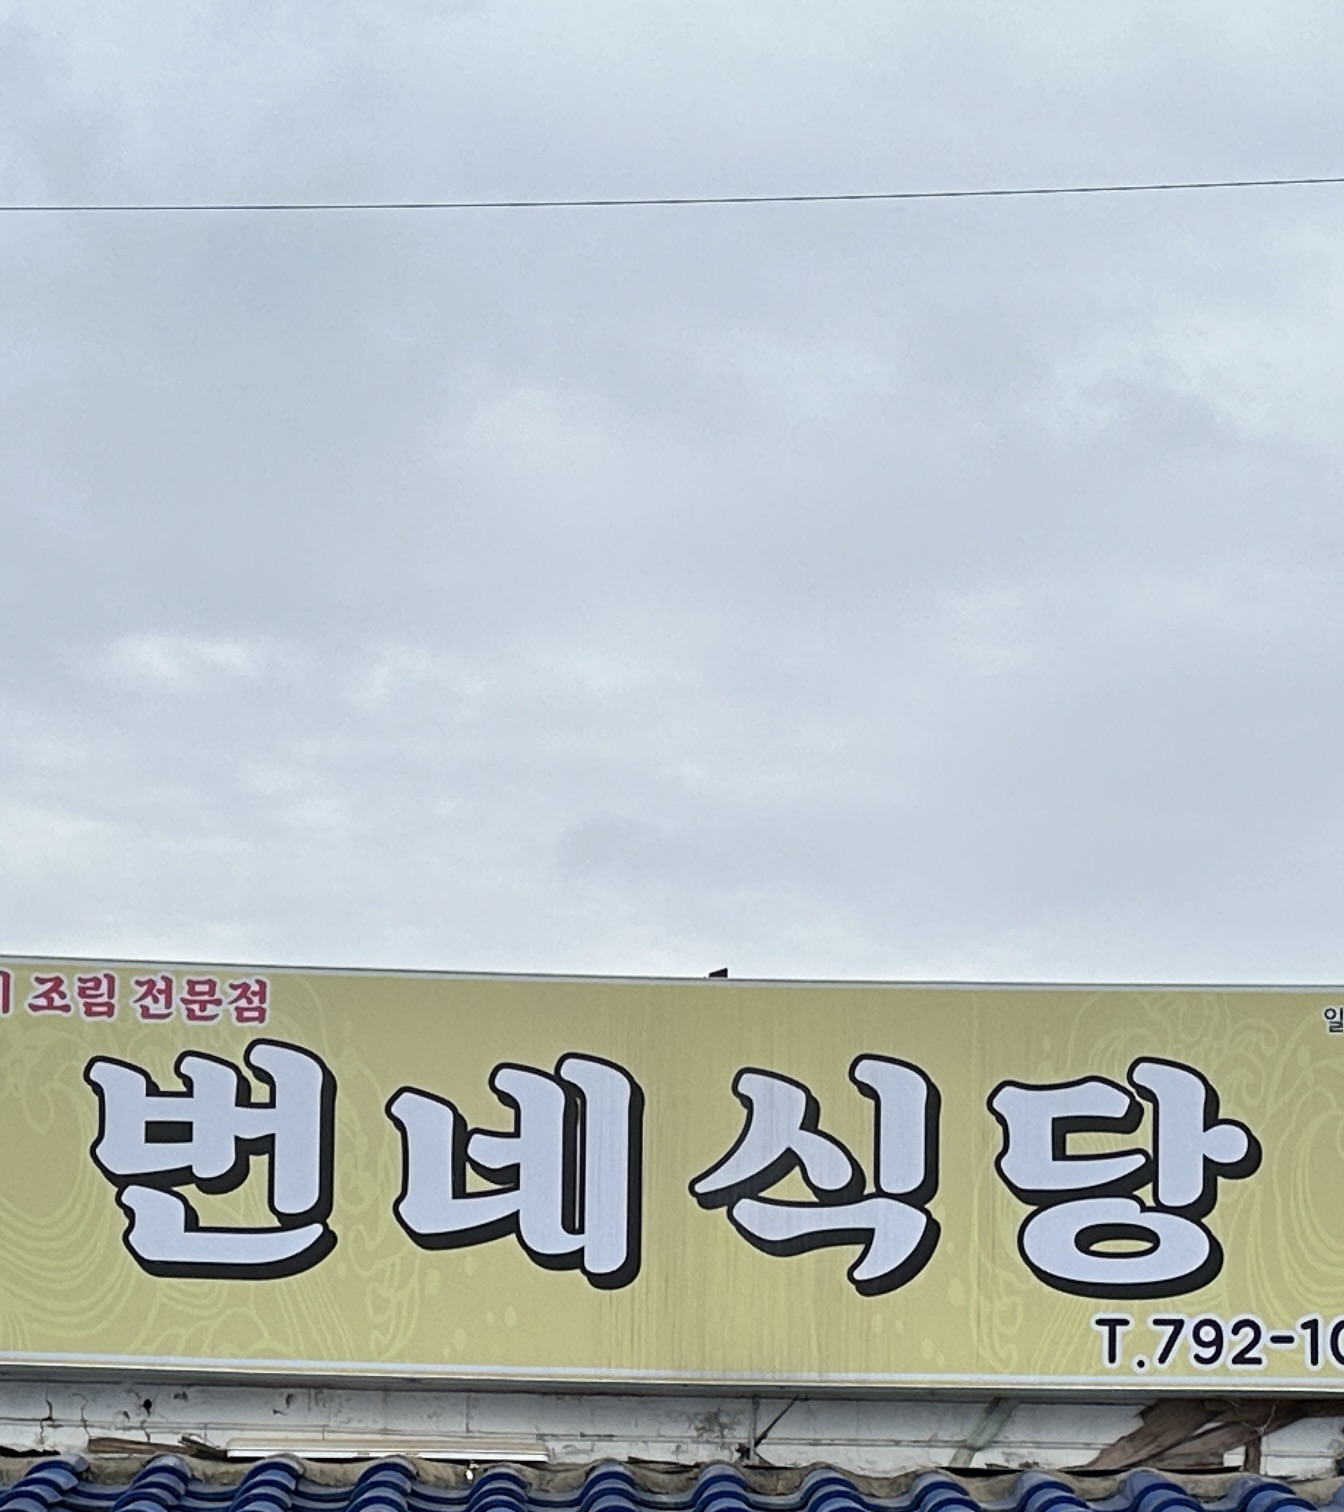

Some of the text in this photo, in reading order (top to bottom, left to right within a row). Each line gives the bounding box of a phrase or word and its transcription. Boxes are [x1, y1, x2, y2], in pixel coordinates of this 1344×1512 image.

[28, 974, 117, 1018] 조림
[133, 977, 269, 1024] 전문점
[84, 1038, 1262, 1300] 번네식당
